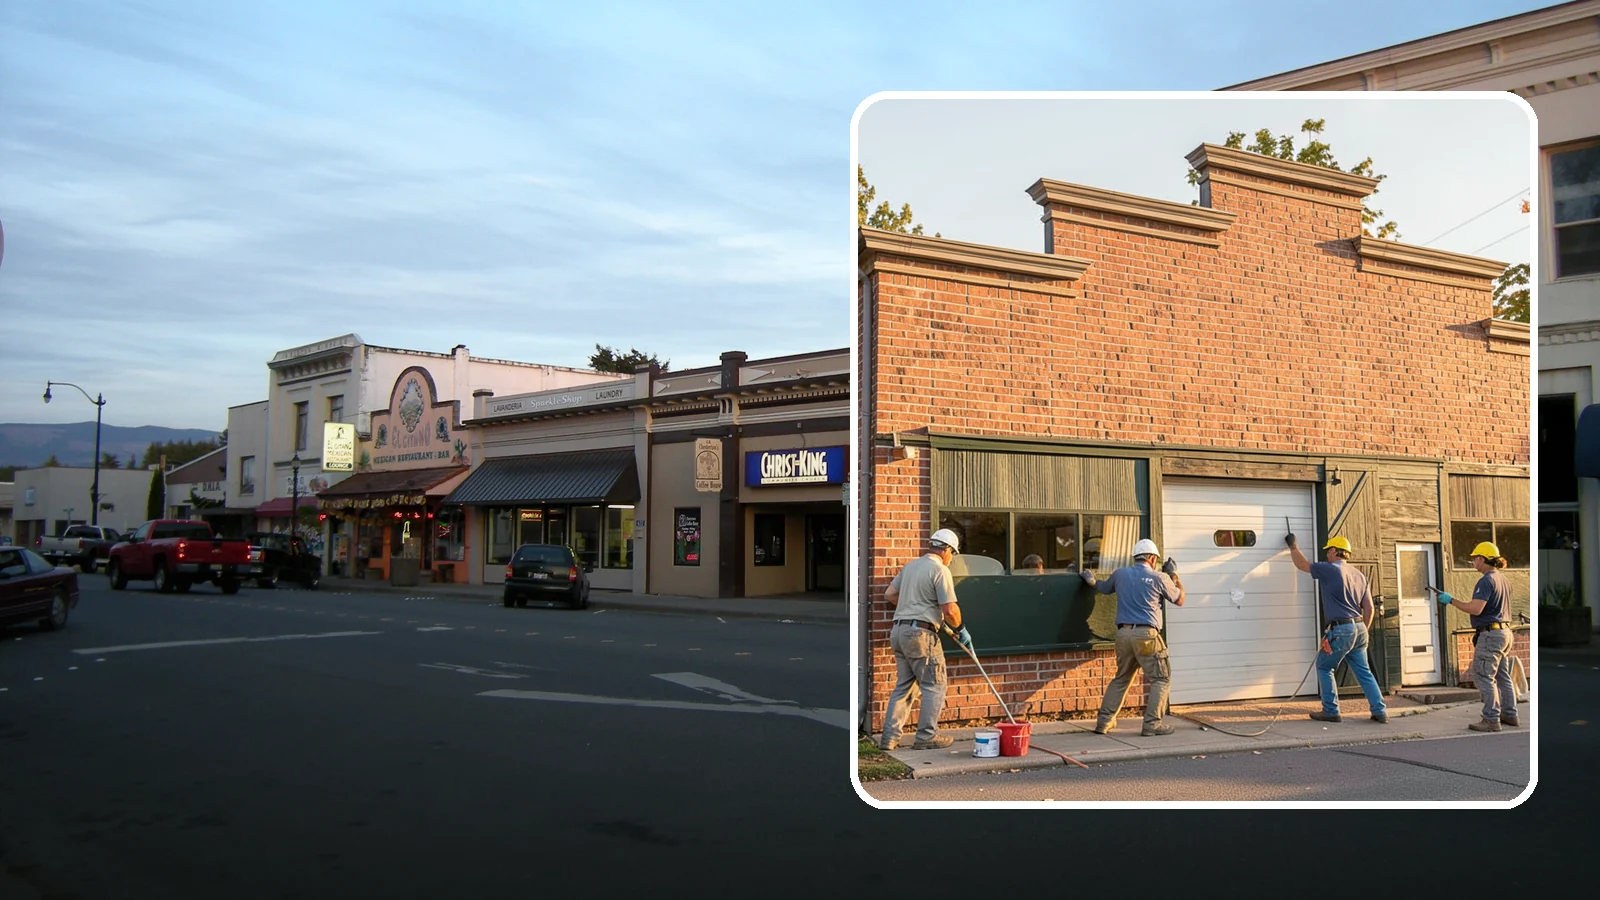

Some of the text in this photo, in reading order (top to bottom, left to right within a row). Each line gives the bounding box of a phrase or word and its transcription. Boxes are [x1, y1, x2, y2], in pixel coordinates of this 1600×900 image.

[595, 389, 623, 400] LAUNDRY
[493, 402, 522, 413] LAVANDERIA
[531, 394, 583, 410] Sparkle Shop
[397, 452, 433, 463] RESTAURANT
[437, 450, 450, 460] BAR
[696, 481, 722, 489] Coffee House
